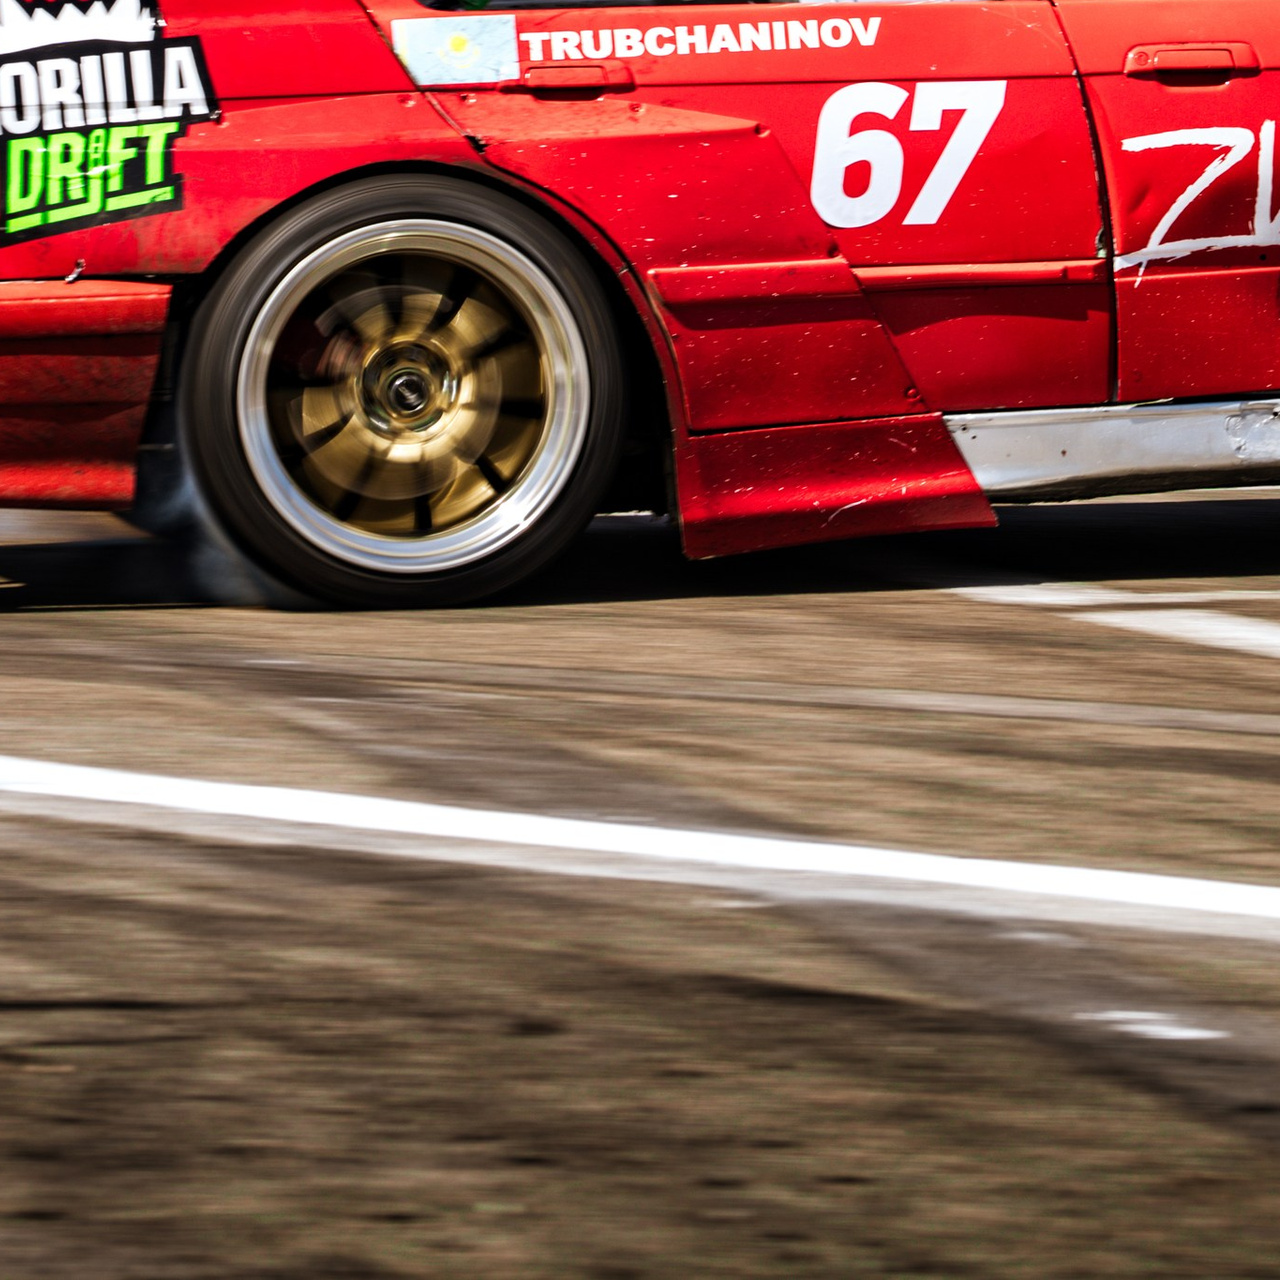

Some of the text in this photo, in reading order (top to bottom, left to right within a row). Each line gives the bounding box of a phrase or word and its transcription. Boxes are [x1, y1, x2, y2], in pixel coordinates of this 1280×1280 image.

[520, 17, 882, 62] TRUBCHANINOV
[0, 46, 210, 136] ORILLA
[6, 122, 180, 217] DRIFT
[811, 80, 1007, 228] 67
